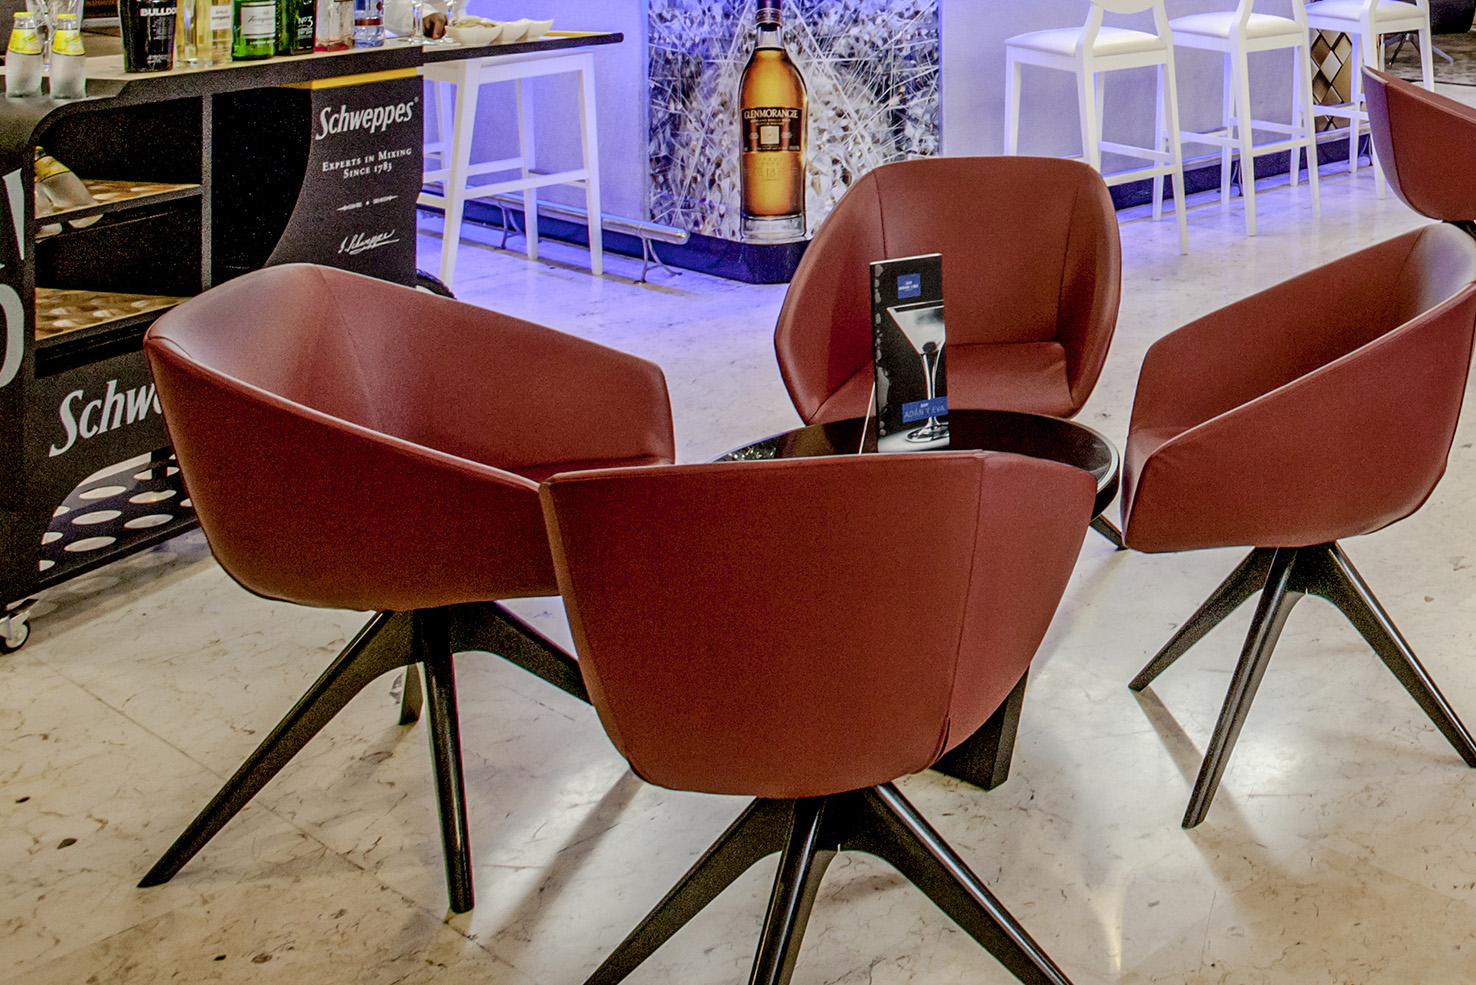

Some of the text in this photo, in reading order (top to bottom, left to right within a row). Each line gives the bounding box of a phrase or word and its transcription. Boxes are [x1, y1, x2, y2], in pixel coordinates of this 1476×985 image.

[744, 109, 798, 119] GLENMORANGIE
[315, 101, 414, 141] Schweppes
[364, 154, 375, 164] IN
[373, 162, 393, 174] 1783
[766, 167, 776, 177] 18
